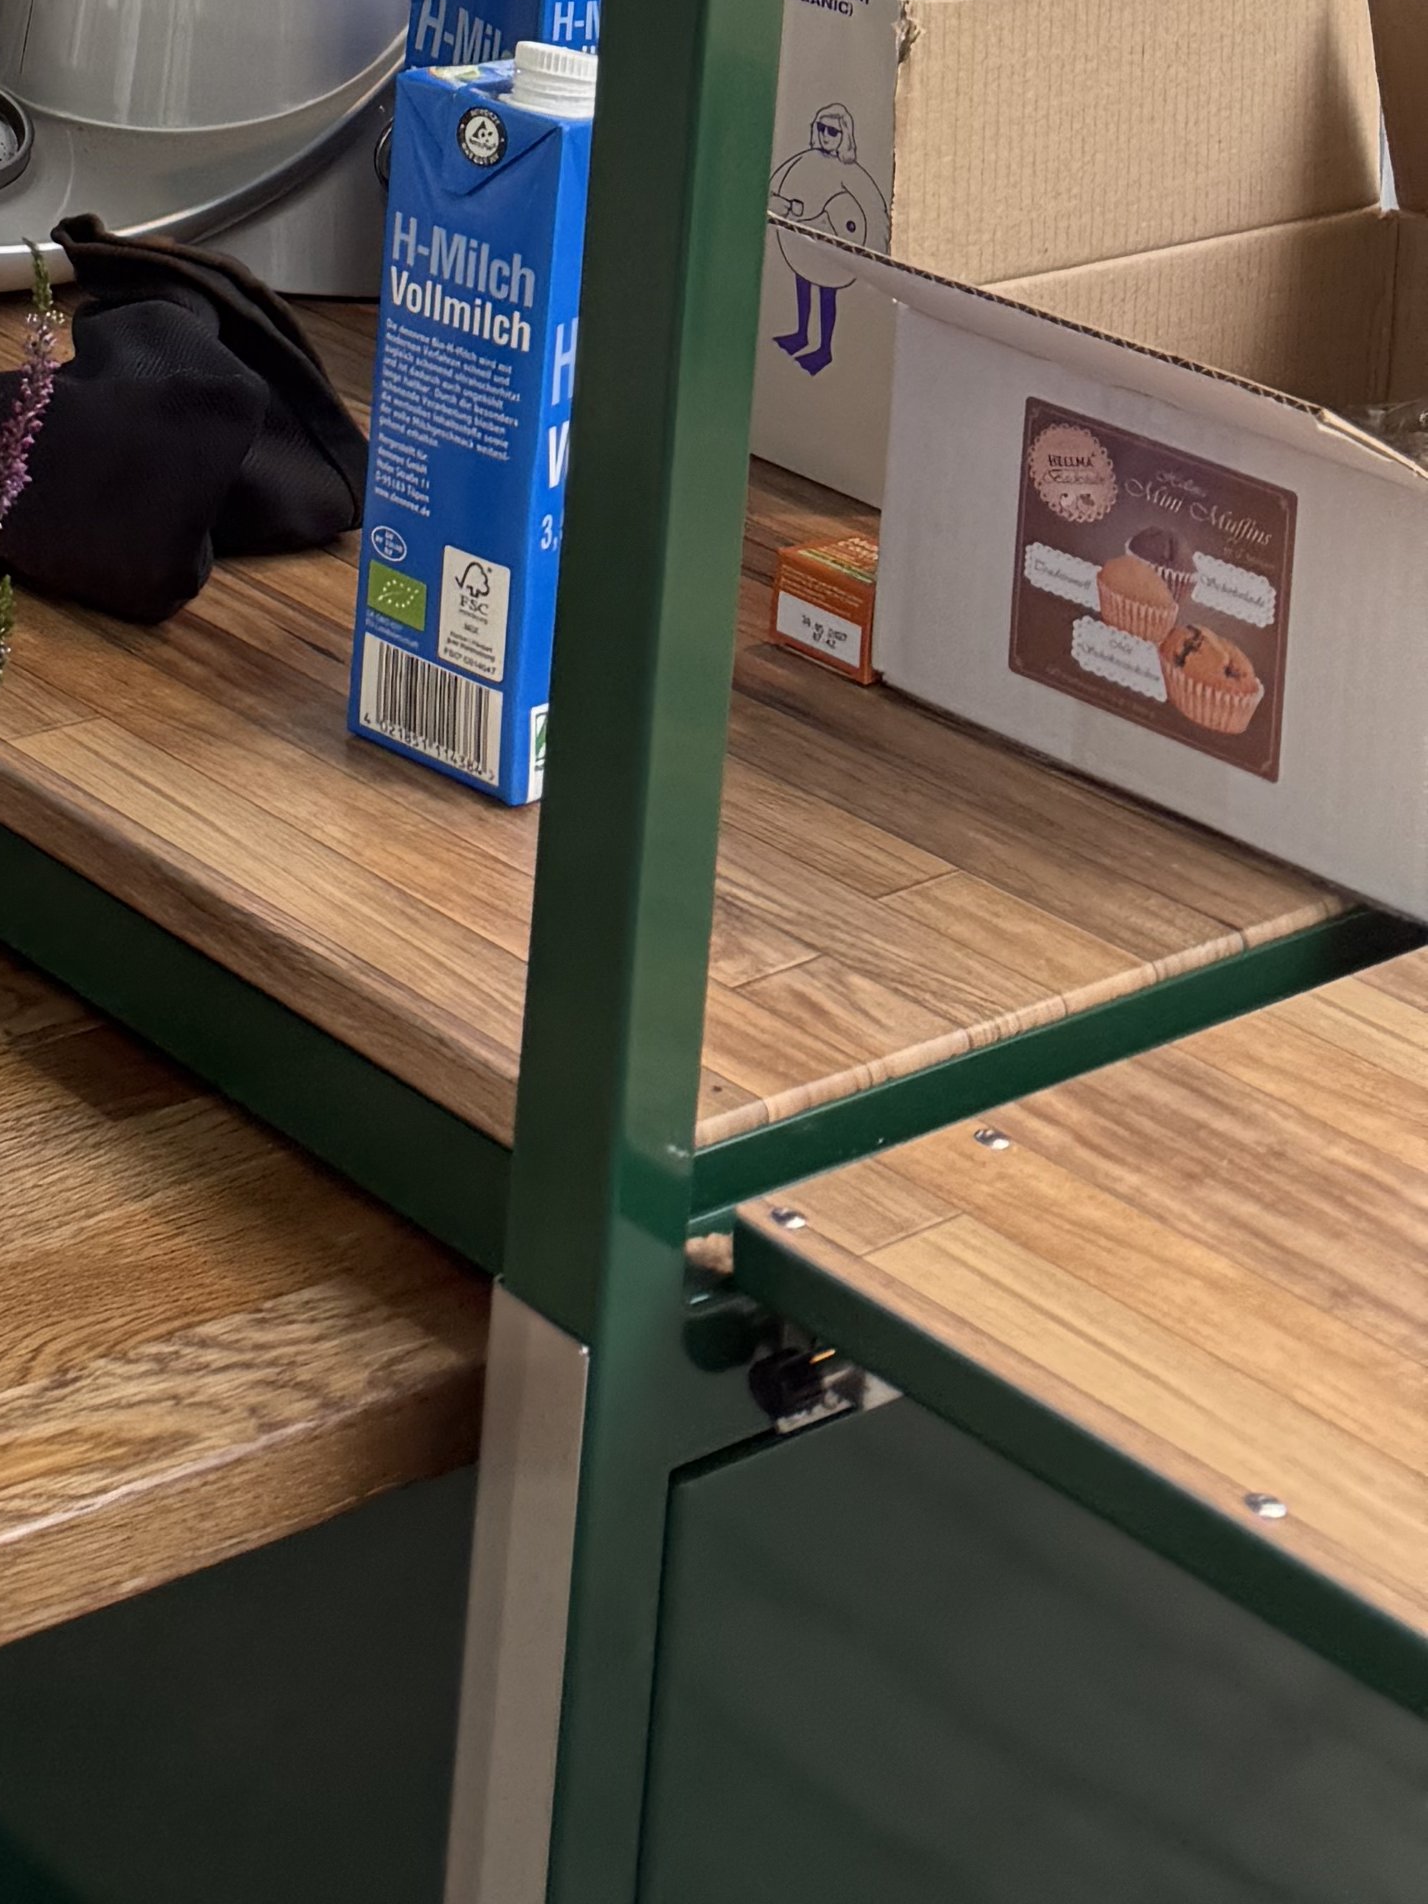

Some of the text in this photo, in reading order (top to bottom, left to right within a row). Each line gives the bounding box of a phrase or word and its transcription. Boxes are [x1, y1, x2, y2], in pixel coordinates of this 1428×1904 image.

[392, 211, 536, 309] H-Milch
[390, 266, 532, 352] Vollmilch
[1125, 478, 1273, 547] Mini Muffins
[459, 594, 488, 616] FSC
